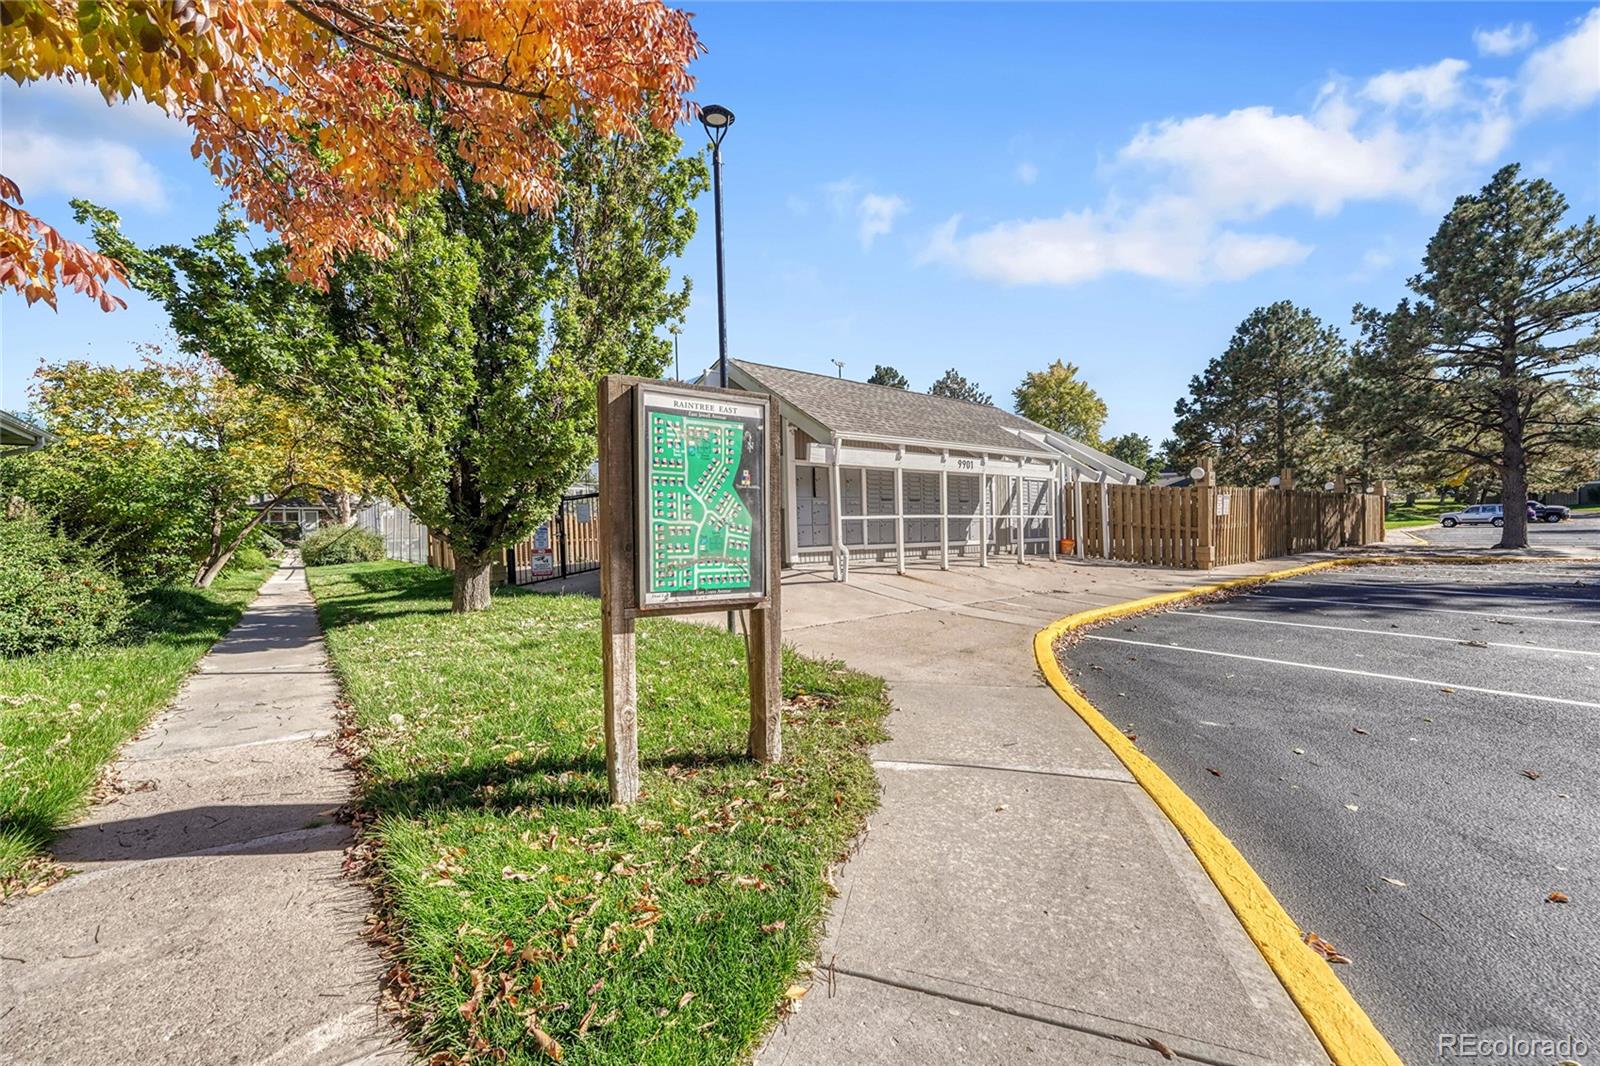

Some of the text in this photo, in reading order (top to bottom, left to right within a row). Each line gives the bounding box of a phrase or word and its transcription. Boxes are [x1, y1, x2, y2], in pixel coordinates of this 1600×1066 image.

[673, 400, 738, 414] RAINTREE EAST
[957, 459, 974, 470] 9901
